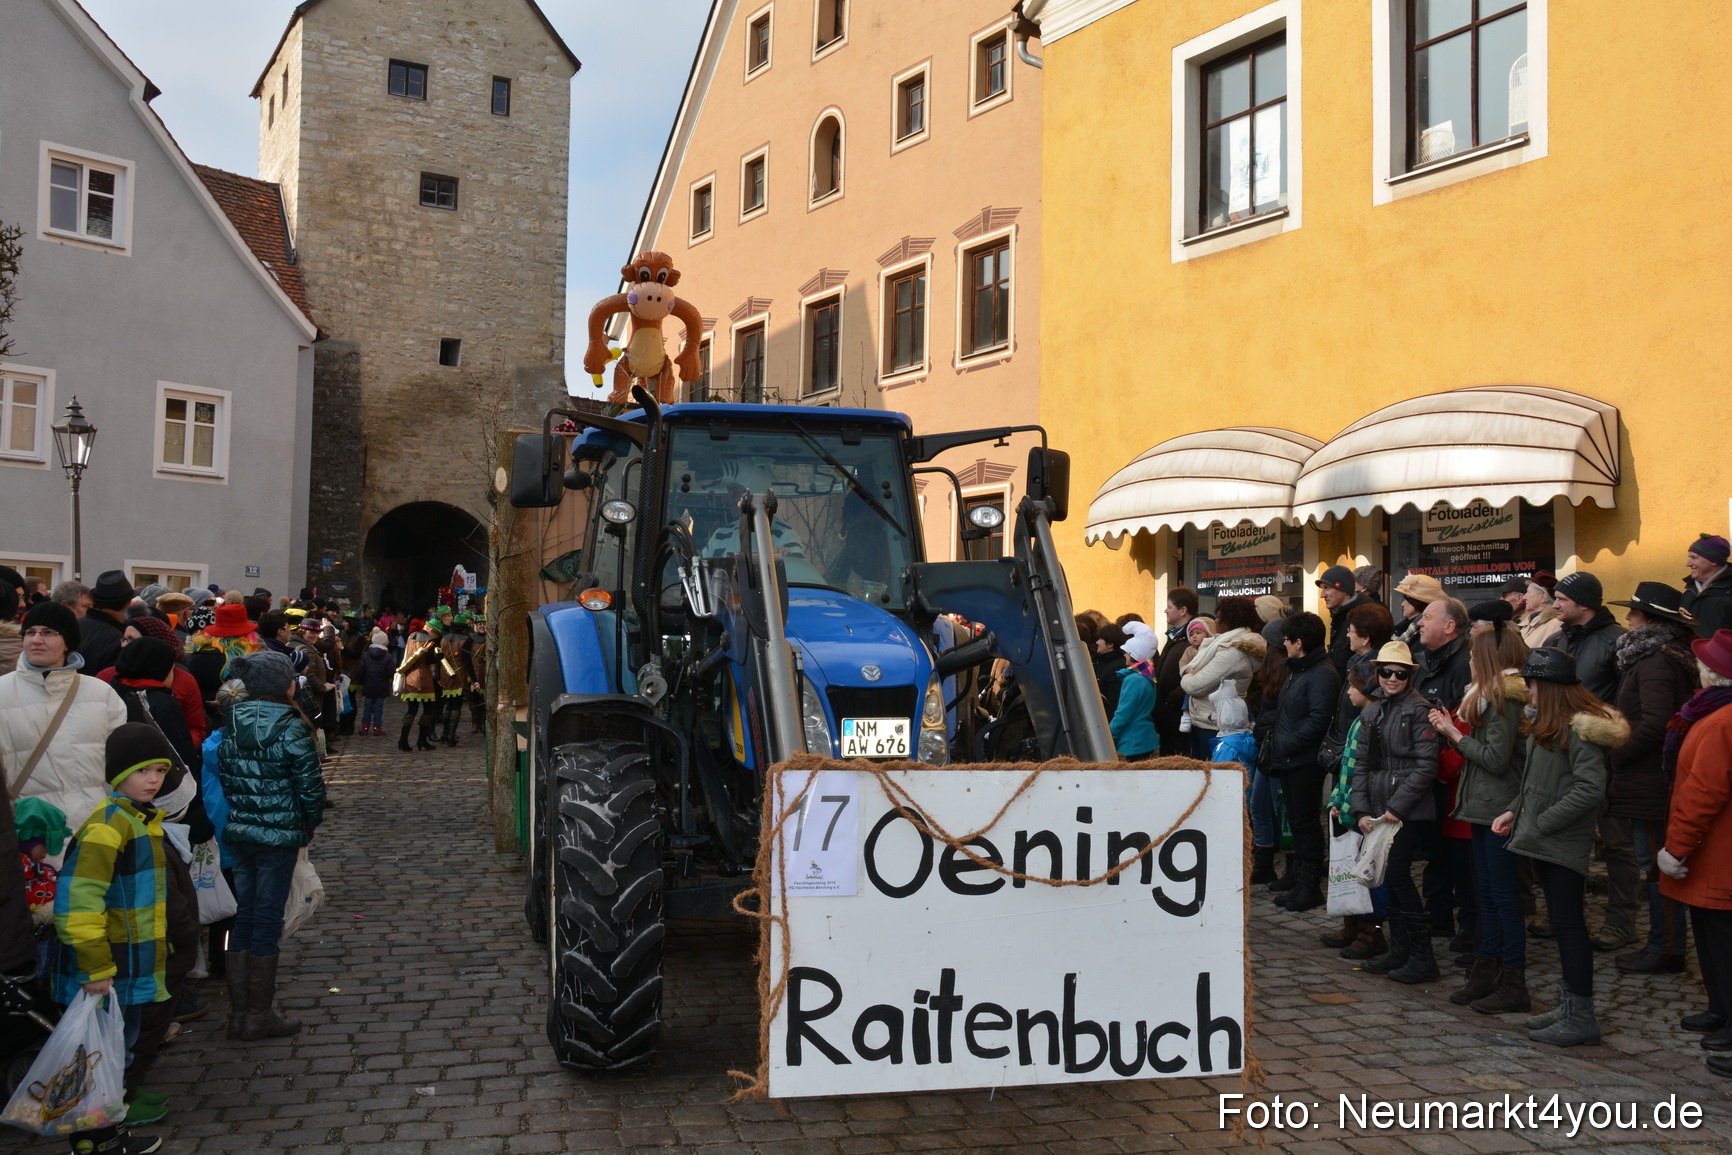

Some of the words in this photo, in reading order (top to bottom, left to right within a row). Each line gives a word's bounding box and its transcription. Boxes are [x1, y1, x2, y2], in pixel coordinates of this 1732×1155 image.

[1429, 503, 1499, 521] Fotoladen
[1214, 525, 1265, 540] Fotoladen
[1438, 513, 1513, 541] Christine
[1220, 533, 1277, 556] Christine
[1433, 544, 1465, 553] Mittwoch
[1467, 543, 1509, 551] Nachmittag
[1450, 553, 1481, 562] geöffnet
[1408, 566, 1449, 576] DIGITALE
[1451, 563, 1511, 574] FARBBILDER
[1513, 561, 1536, 571] VON
[466, 575, 475, 584] 19
[1197, 580, 1229, 589] EINFACH
[1244, 575, 1294, 586] BILDSCHM
[1444, 573, 1532, 585] SPEICHERMEDEN
[1218, 587, 1266, 597] AUSSUCHEN
[856, 721, 877, 737] NM
[847, 738, 868, 754] AW
[875, 738, 906, 754] 676
[788, 795, 850, 851] 17
[864, 805, 1207, 917] Oening
[785, 966, 1242, 1077] Raitenbuch
